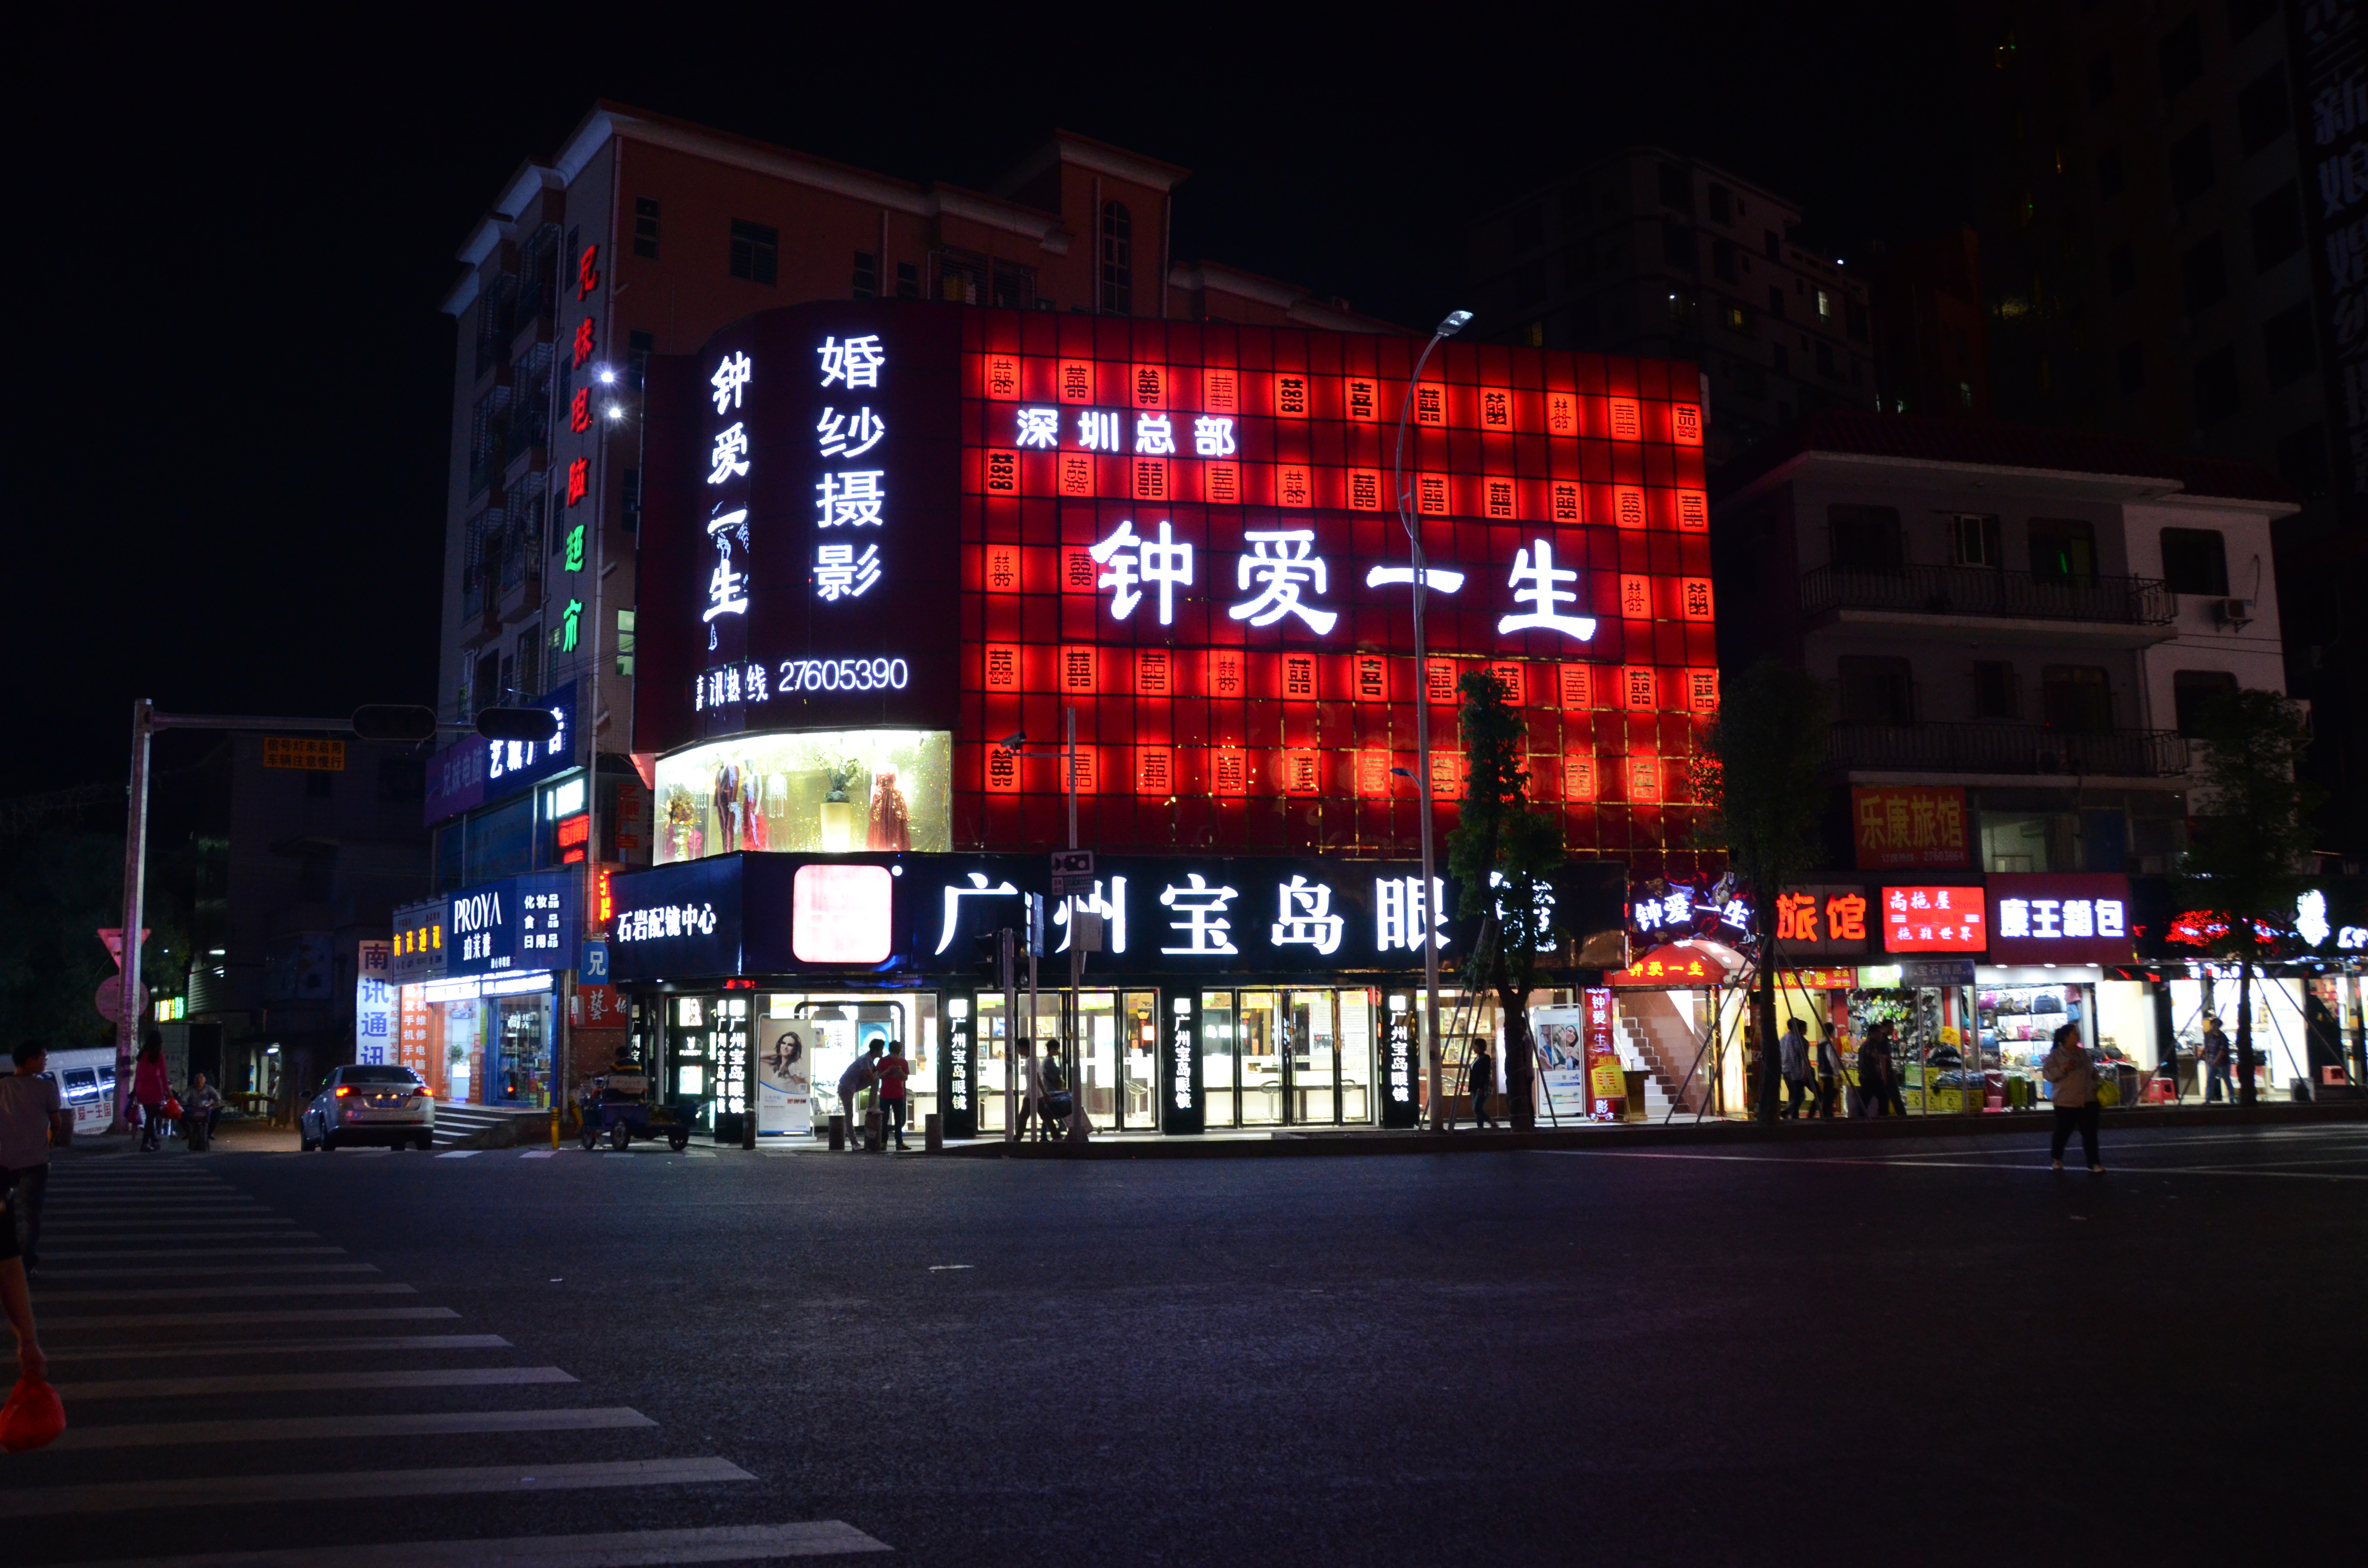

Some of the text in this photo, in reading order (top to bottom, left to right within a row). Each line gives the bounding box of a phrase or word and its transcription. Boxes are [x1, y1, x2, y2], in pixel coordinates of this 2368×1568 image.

[1016, 408, 1236, 456] 深圳总部
[703, 351, 752, 623] 钟爱一生
[813, 334, 885, 601] 婚纱摄影
[1089, 521, 1596, 641] 钟爱一生
[779, 658, 908, 692] 27605390
[267, 754, 342, 769] 车辆注意慢行
[268, 739, 342, 754] 信号灯未启用
[1860, 794, 1964, 849] 乐康旅馆
[454, 892, 502, 934] PROYA
[524, 894, 559, 909] 化妆品
[617, 903, 717, 943] 石岩配镜中心
[934, 872, 1558, 955] 广州宝岛眼
[1635, 892, 1750, 932] 钟爱一生
[1776, 892, 1867, 943] 旅馆
[1889, 891, 1951, 912] 尚拖屋
[393, 925, 441, 956] 南讯通讯
[524, 933, 558, 949] 日用品
[1628, 960, 1704, 978] 钟爱一生
[390, 989, 400, 1066] 手机配件批发零
[1591, 995, 1607, 1047] 钟爱一生
[728, 1016, 746, 1114] 广州宝岛眼镜
[950, 1017, 967, 1111] 广州宝岛眼镜
[1174, 1014, 1193, 1109] 广州宝岛眼镜
[1391, 1010, 1409, 1102] 广州宝岛眼镜
